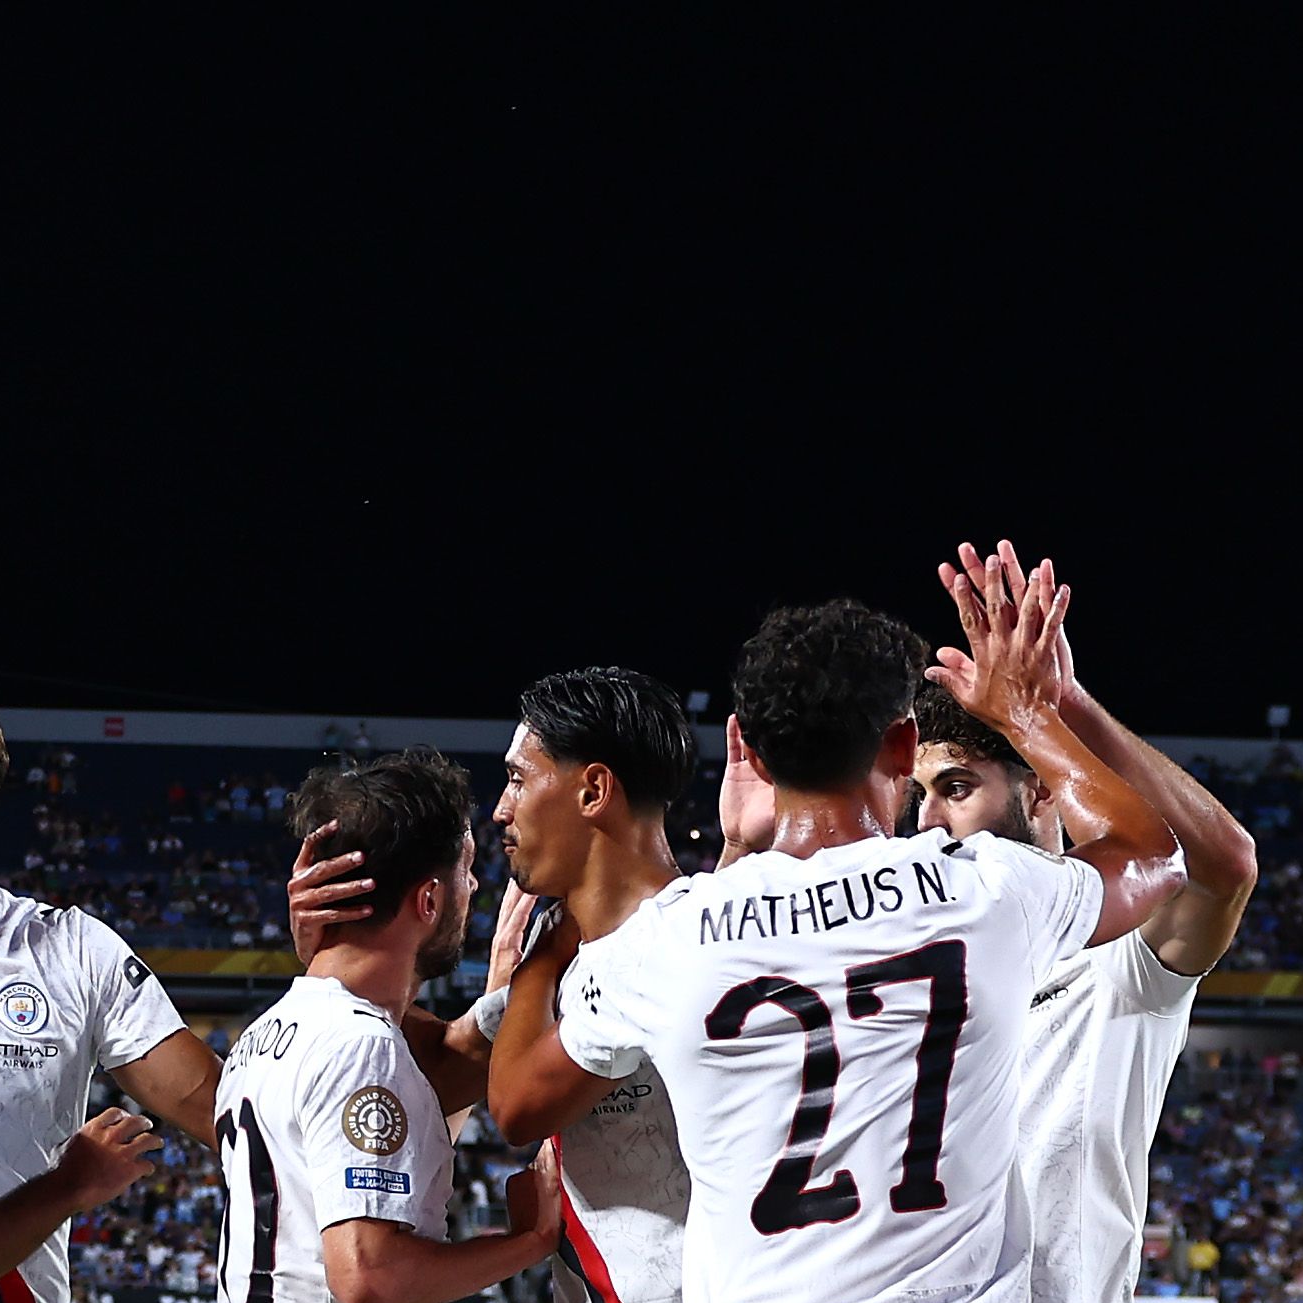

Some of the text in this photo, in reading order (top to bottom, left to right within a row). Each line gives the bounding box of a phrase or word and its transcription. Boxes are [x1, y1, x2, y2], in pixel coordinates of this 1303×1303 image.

[700, 862, 957, 945] MATHEUS N.
[704, 939, 968, 1236] 27
[350, 1092, 379, 1113] WORLD
[381, 1095, 396, 1109] CUP
[591, 1103, 635, 1116] AIRWAYS
[348, 1116, 362, 1139] CLUB
[364, 1139, 389, 1150] FIFA
[352, 1168, 381, 1178] FOOTBALL
